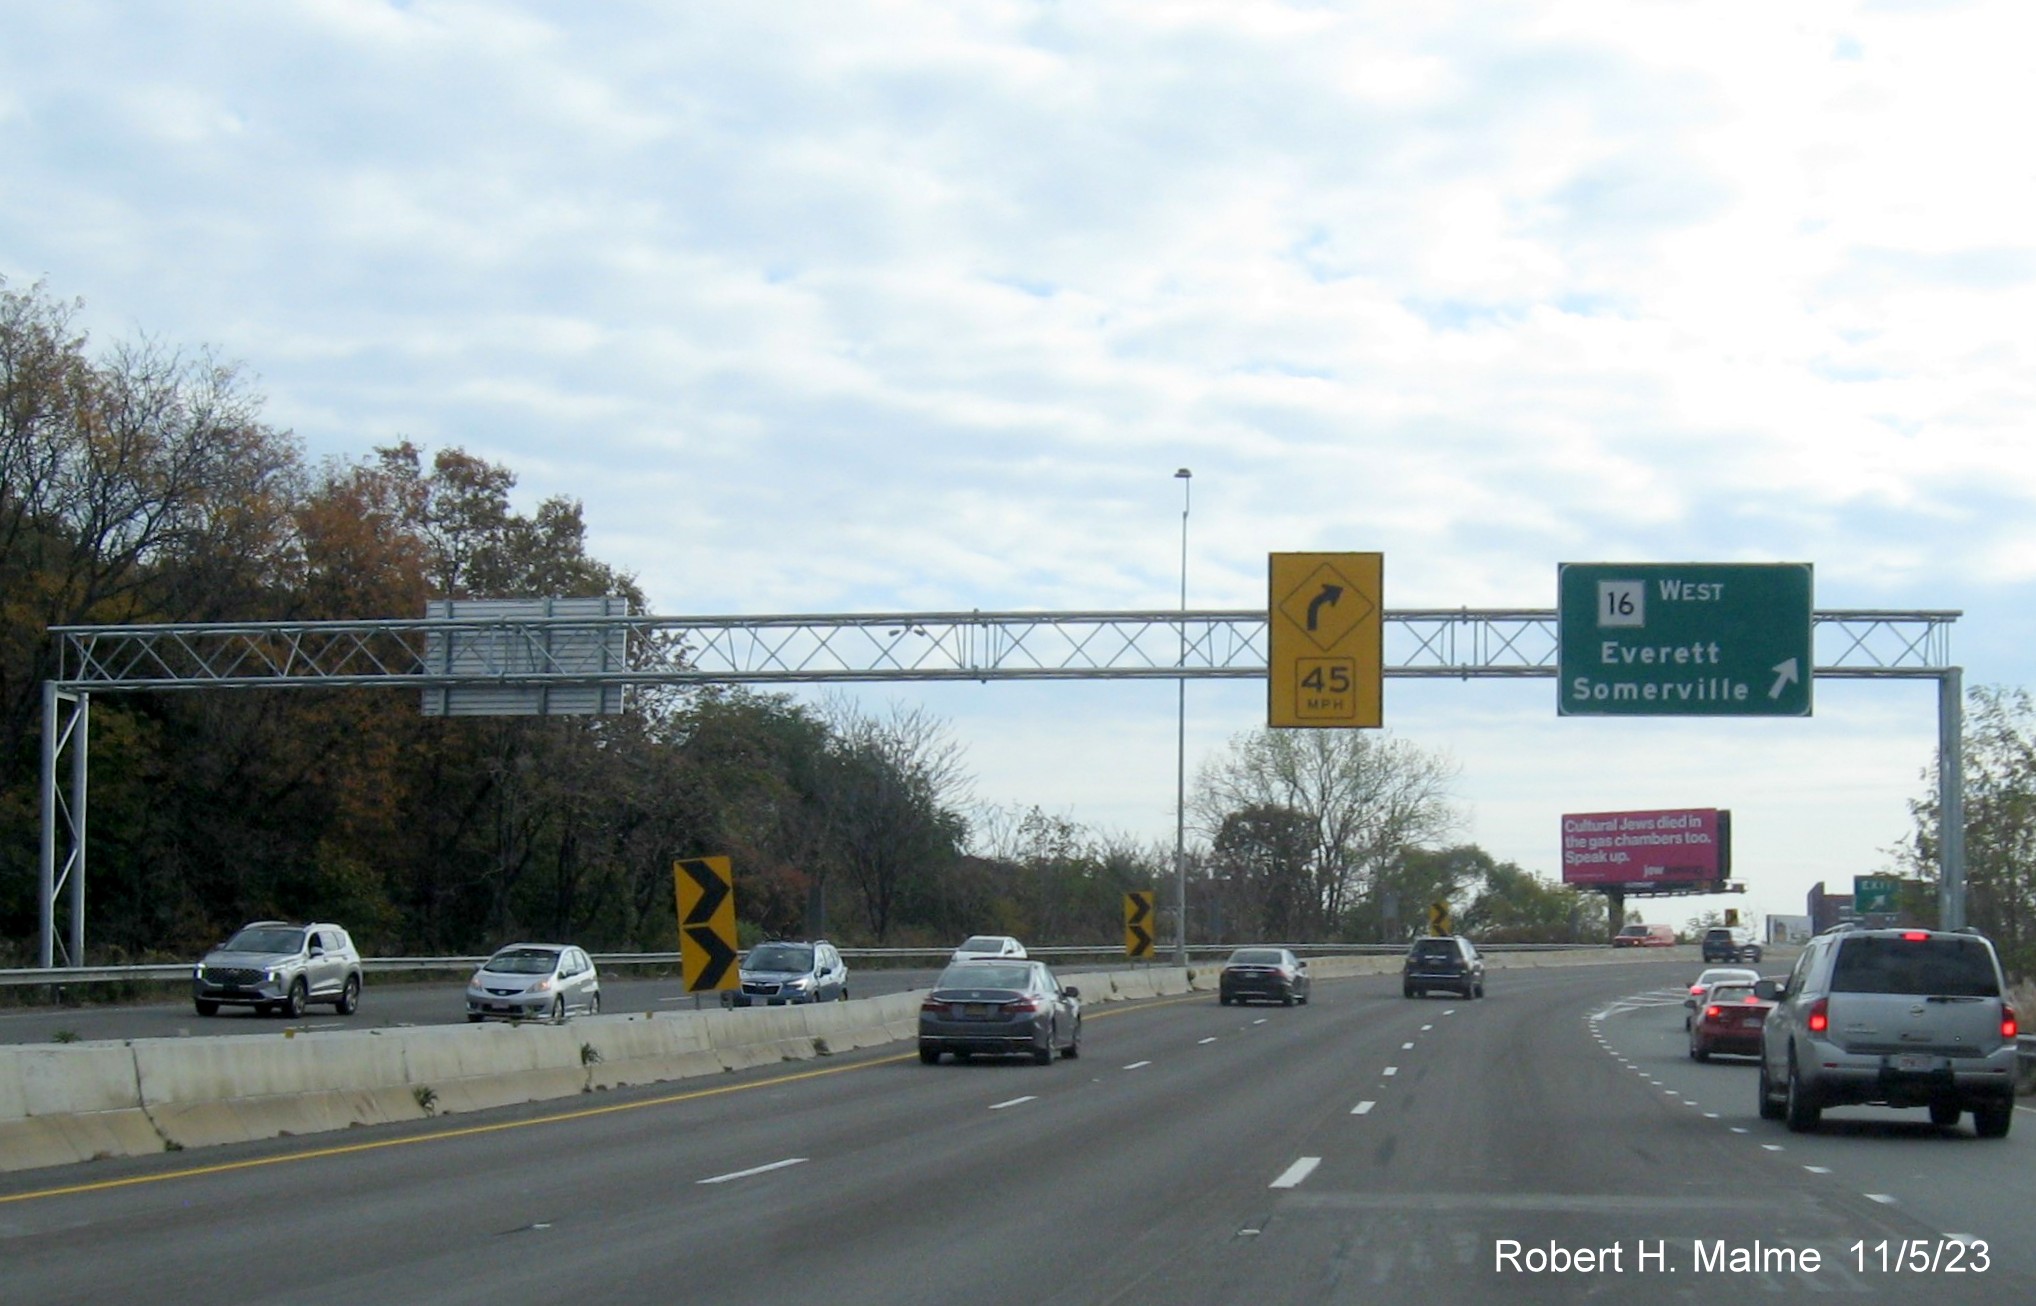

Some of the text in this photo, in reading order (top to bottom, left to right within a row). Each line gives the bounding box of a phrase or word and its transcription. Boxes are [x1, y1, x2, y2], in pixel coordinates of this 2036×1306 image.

[1607, 591, 1635, 616] 16
[1601, 641, 1720, 664] Everett
[1301, 666, 1350, 694] 45
[1572, 677, 1749, 701] Somerville
[1307, 700, 1343, 710] MPH
[1565, 815, 1701, 833] Cultural Jews died in
[1565, 832, 1712, 849] the gas chambers too.
[1565, 851, 1630, 866] Speak up.
